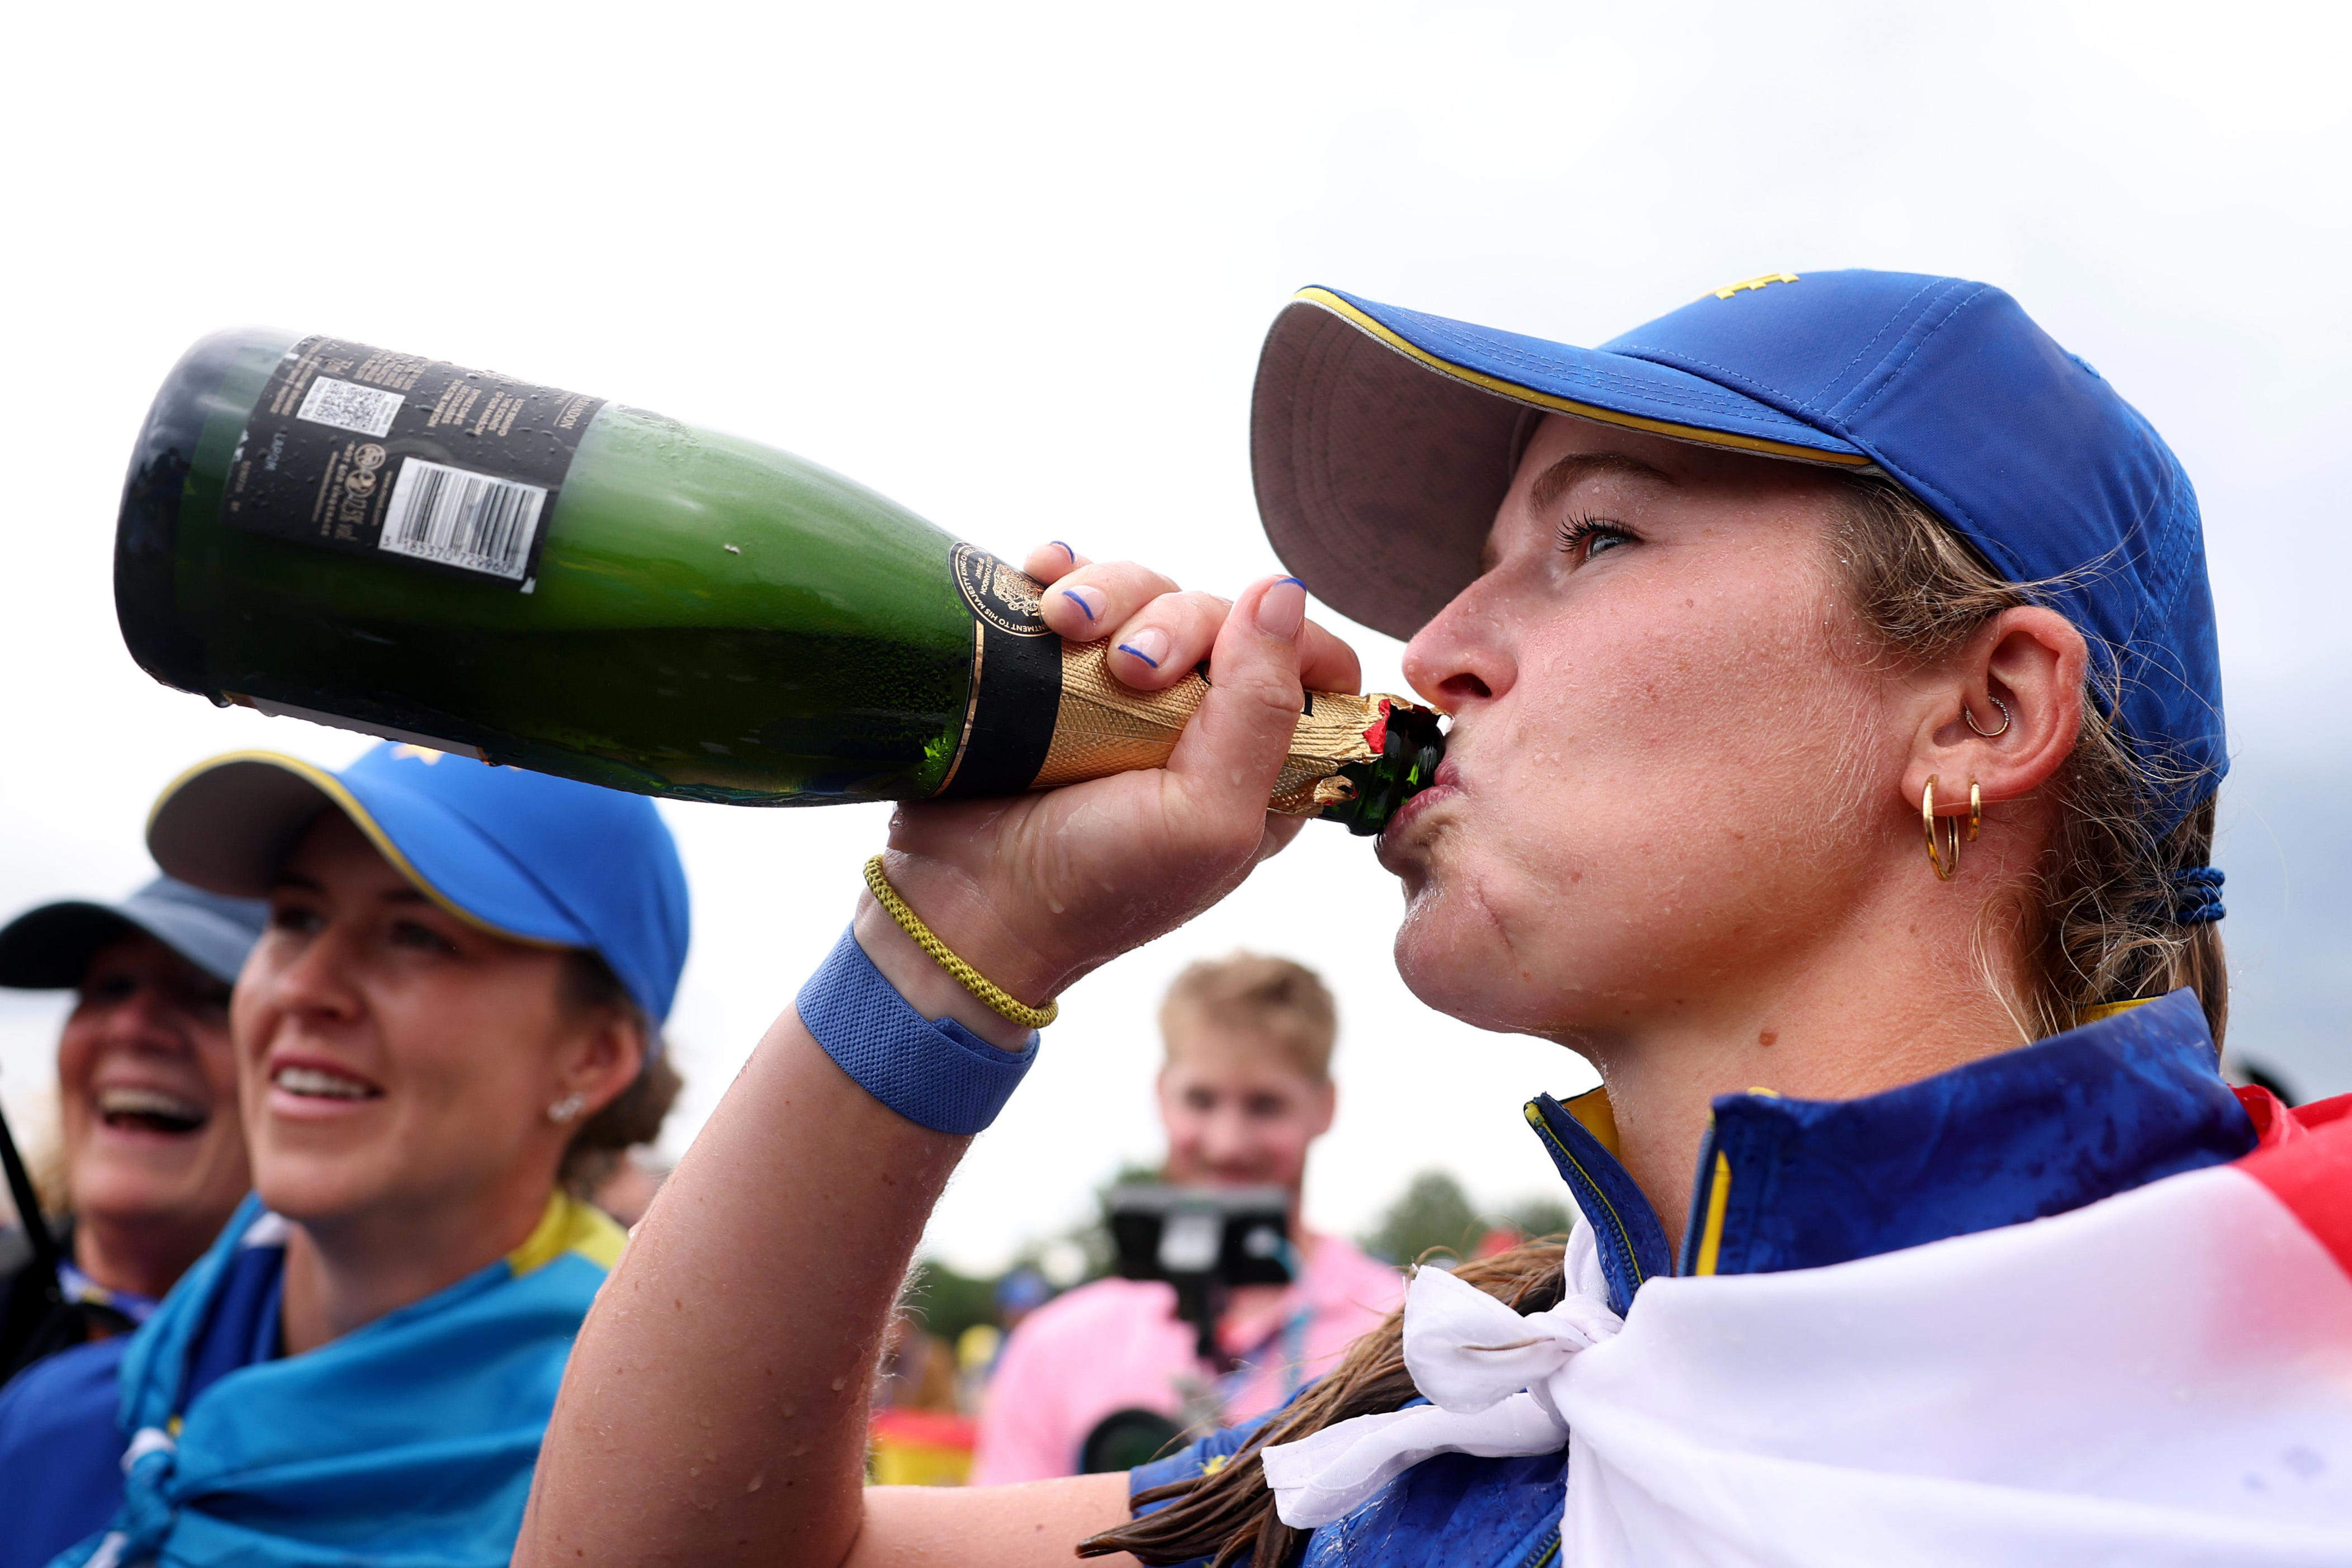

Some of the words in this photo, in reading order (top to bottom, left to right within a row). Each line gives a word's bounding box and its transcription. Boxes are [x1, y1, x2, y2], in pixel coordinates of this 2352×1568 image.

[487, 398, 500, 410] OUR
[500, 397, 514, 409] THE
[474, 409, 494, 435] MAISON
[486, 408, 507, 431] SCENES
[496, 411, 518, 437] BEHIND
[403, 538, 453, 561] 185370
[459, 552, 511, 574] 729960
[959, 560, 968, 576] KING
[979, 567, 992, 595] CHANDON
[962, 577, 986, 610] MAJESTY
[985, 608, 998, 621] HIS
[998, 618, 1010, 628] TO
